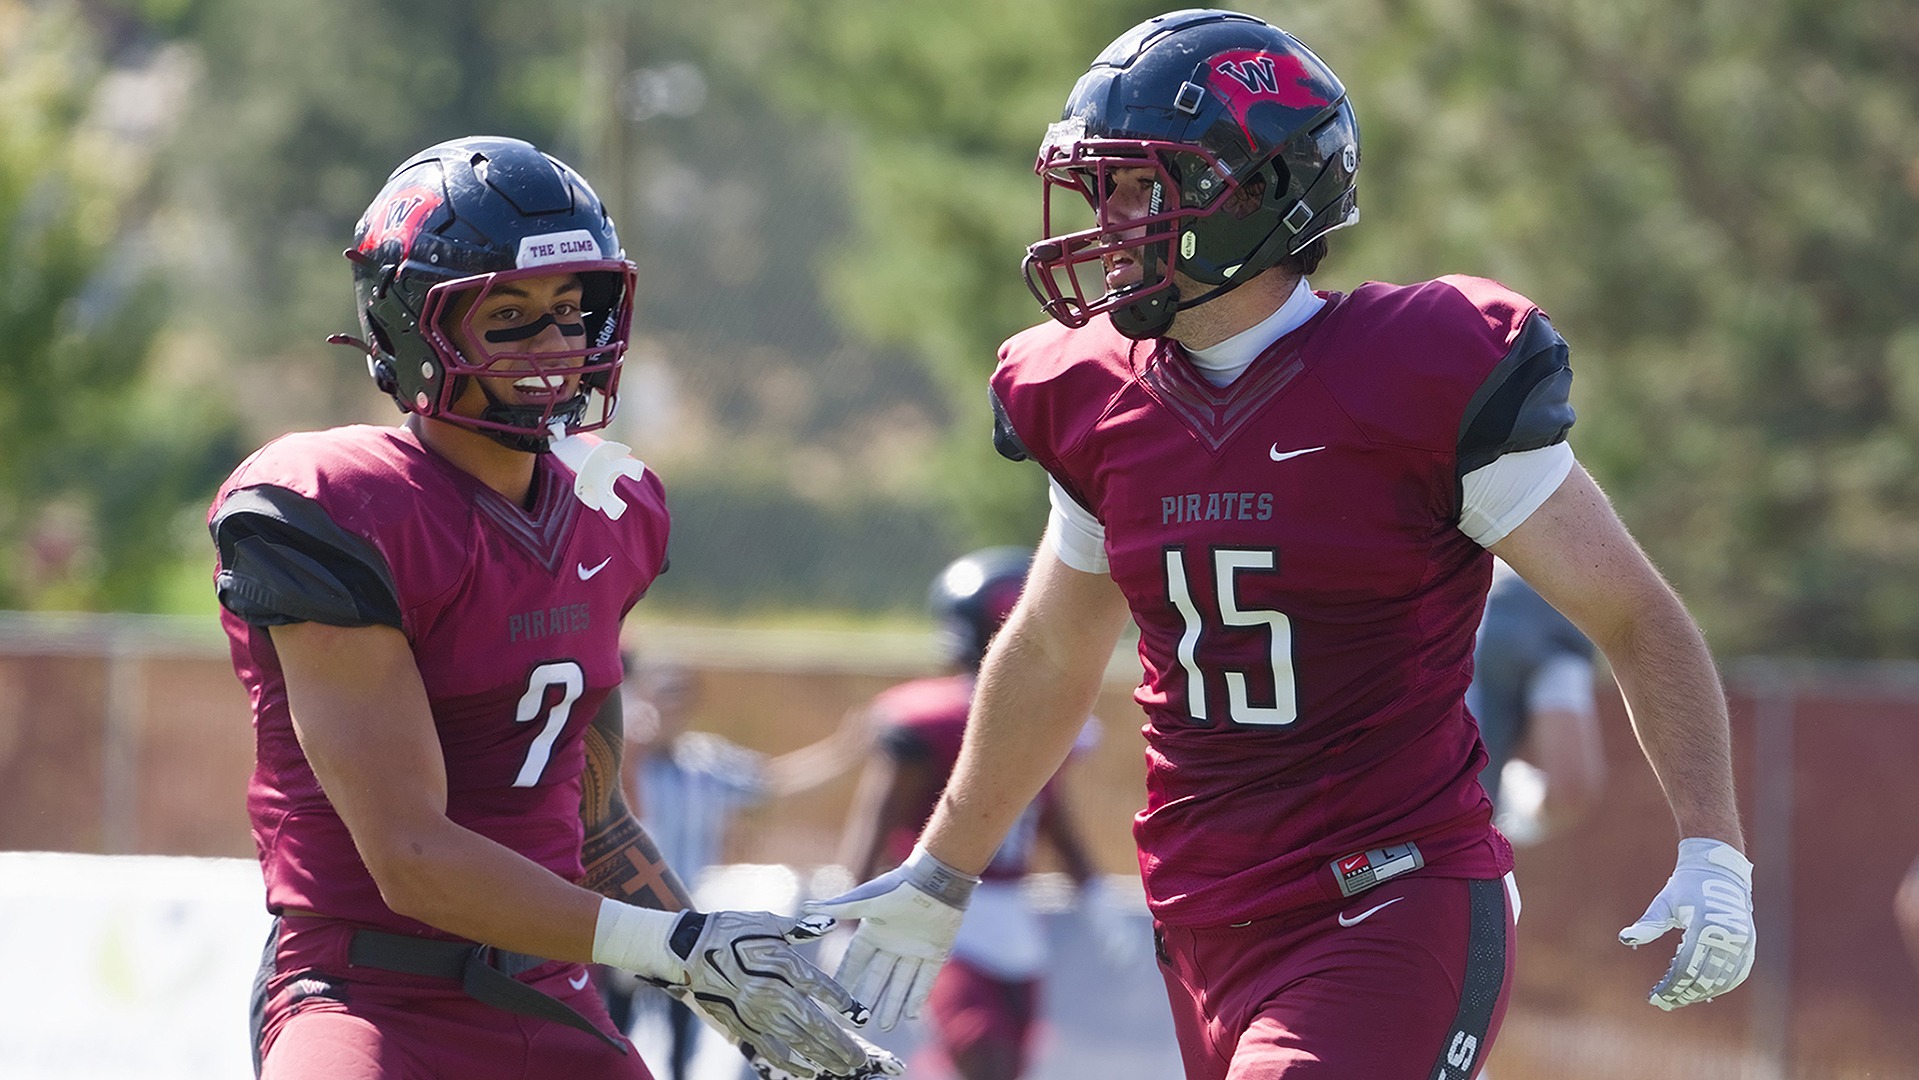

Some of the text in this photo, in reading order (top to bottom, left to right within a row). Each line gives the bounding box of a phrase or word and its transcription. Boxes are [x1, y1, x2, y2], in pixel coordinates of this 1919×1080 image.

[1216, 57, 1279, 94] W
[1344, 150, 1355, 168] 76
[384, 195, 425, 233] W
[1149, 181, 1163, 217] schut
[529, 239, 594, 258] THE CLIMB
[588, 316, 617, 361] Rddell
[1161, 492, 1274, 525] PIRATES
[508, 603, 590, 643] PIRATES
[1164, 549, 1298, 725] 15
[1346, 865, 1370, 878] TEAM
[1381, 849, 1395, 860] L
